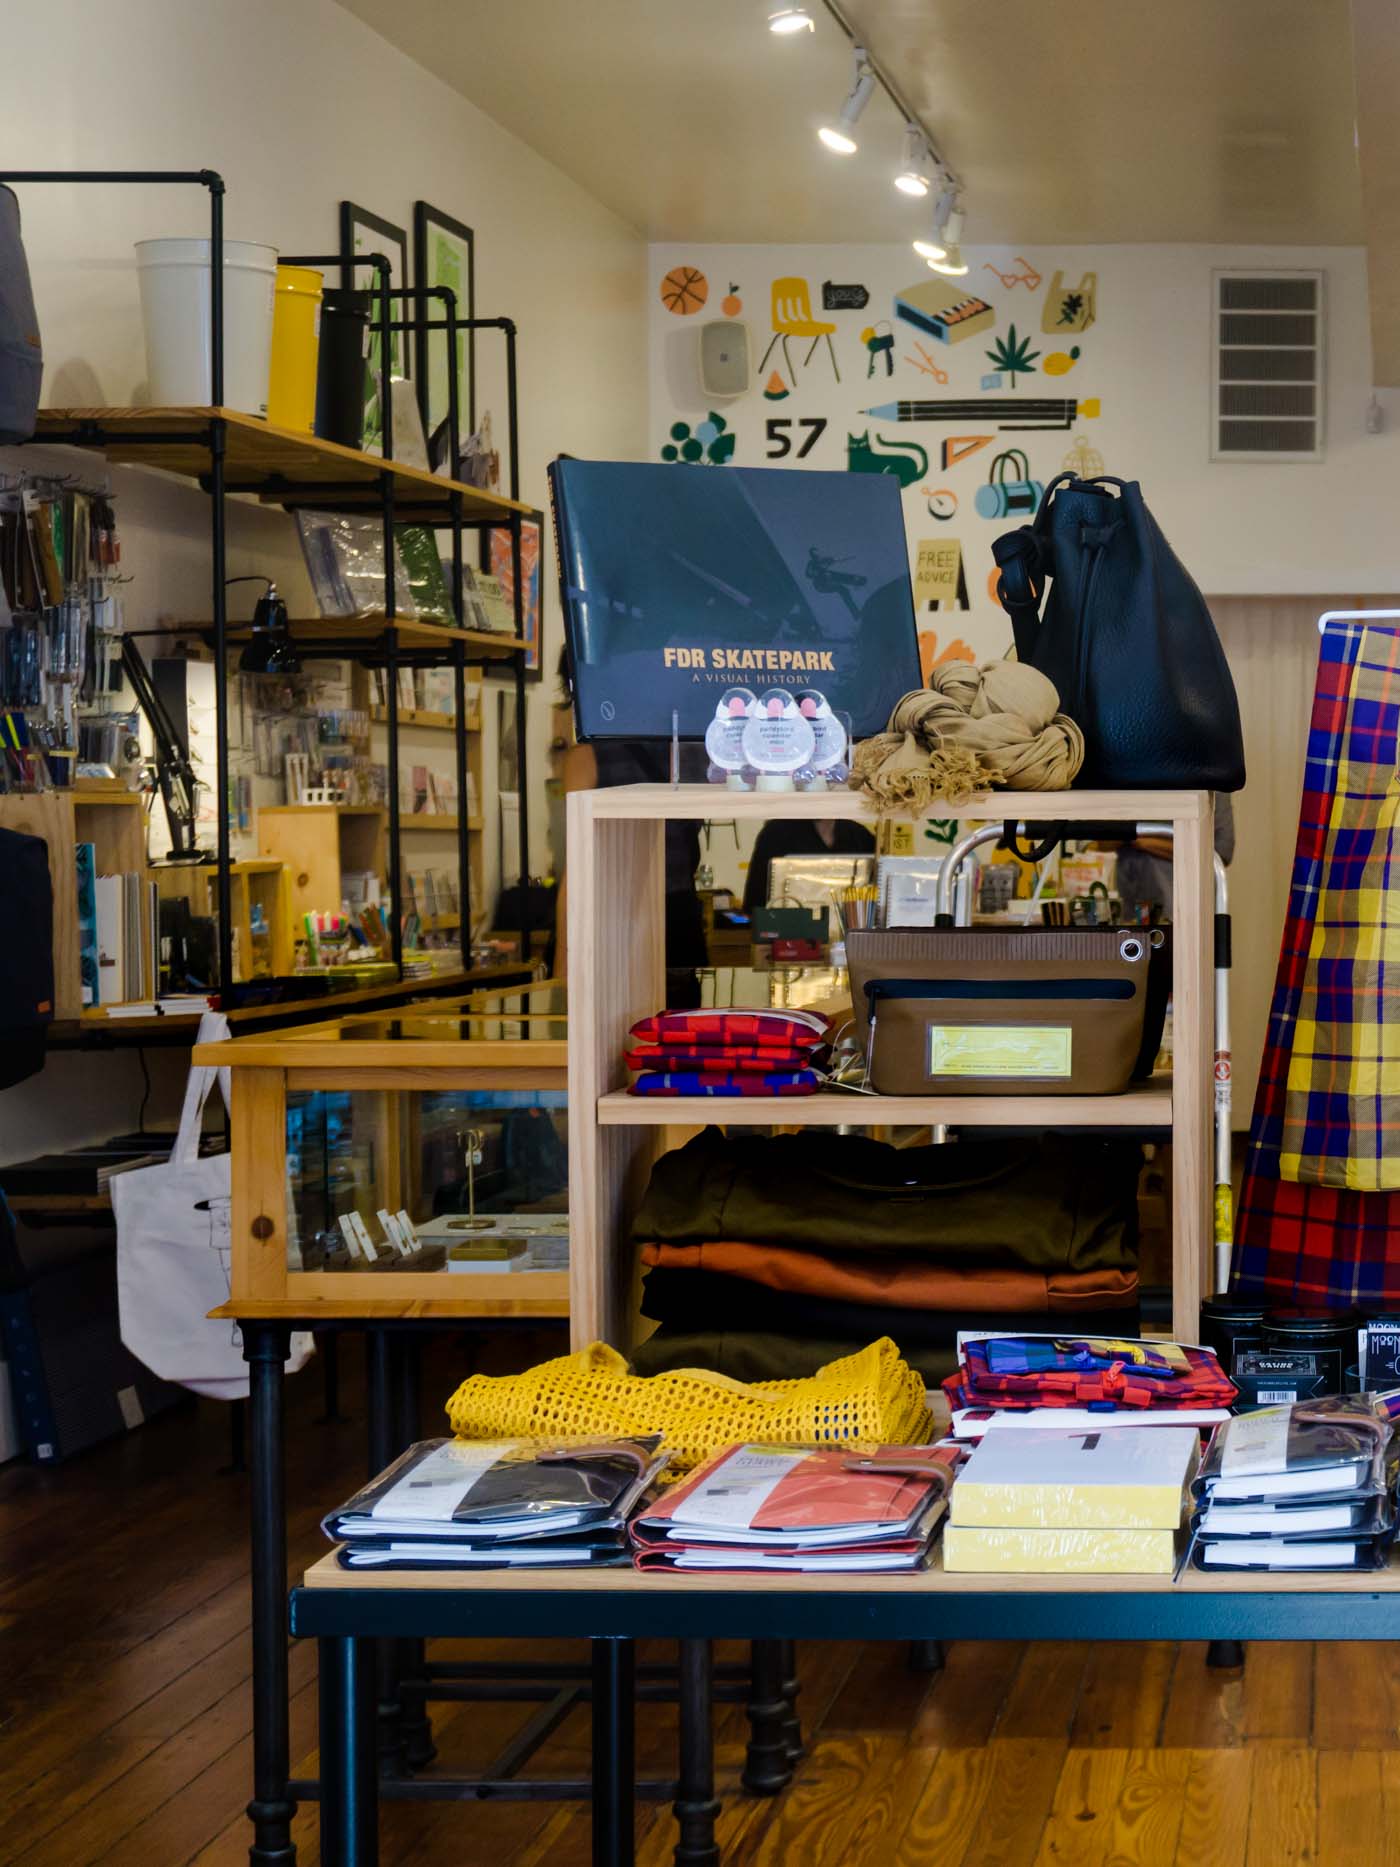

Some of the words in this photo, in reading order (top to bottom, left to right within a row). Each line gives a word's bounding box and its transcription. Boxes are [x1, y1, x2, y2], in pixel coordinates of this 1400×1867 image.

[766, 418, 827, 458] 57
[918, 551, 955, 568] FREE
[917, 571, 955, 584] ADVICE
[664, 648, 706, 668] FDR
[712, 648, 835, 671] SKATEPARK
[692, 674, 700, 683] A
[706, 674, 750, 683] VISUAL
[756, 674, 810, 685] HISTORY
[1371, 1335, 1400, 1355] MOON
